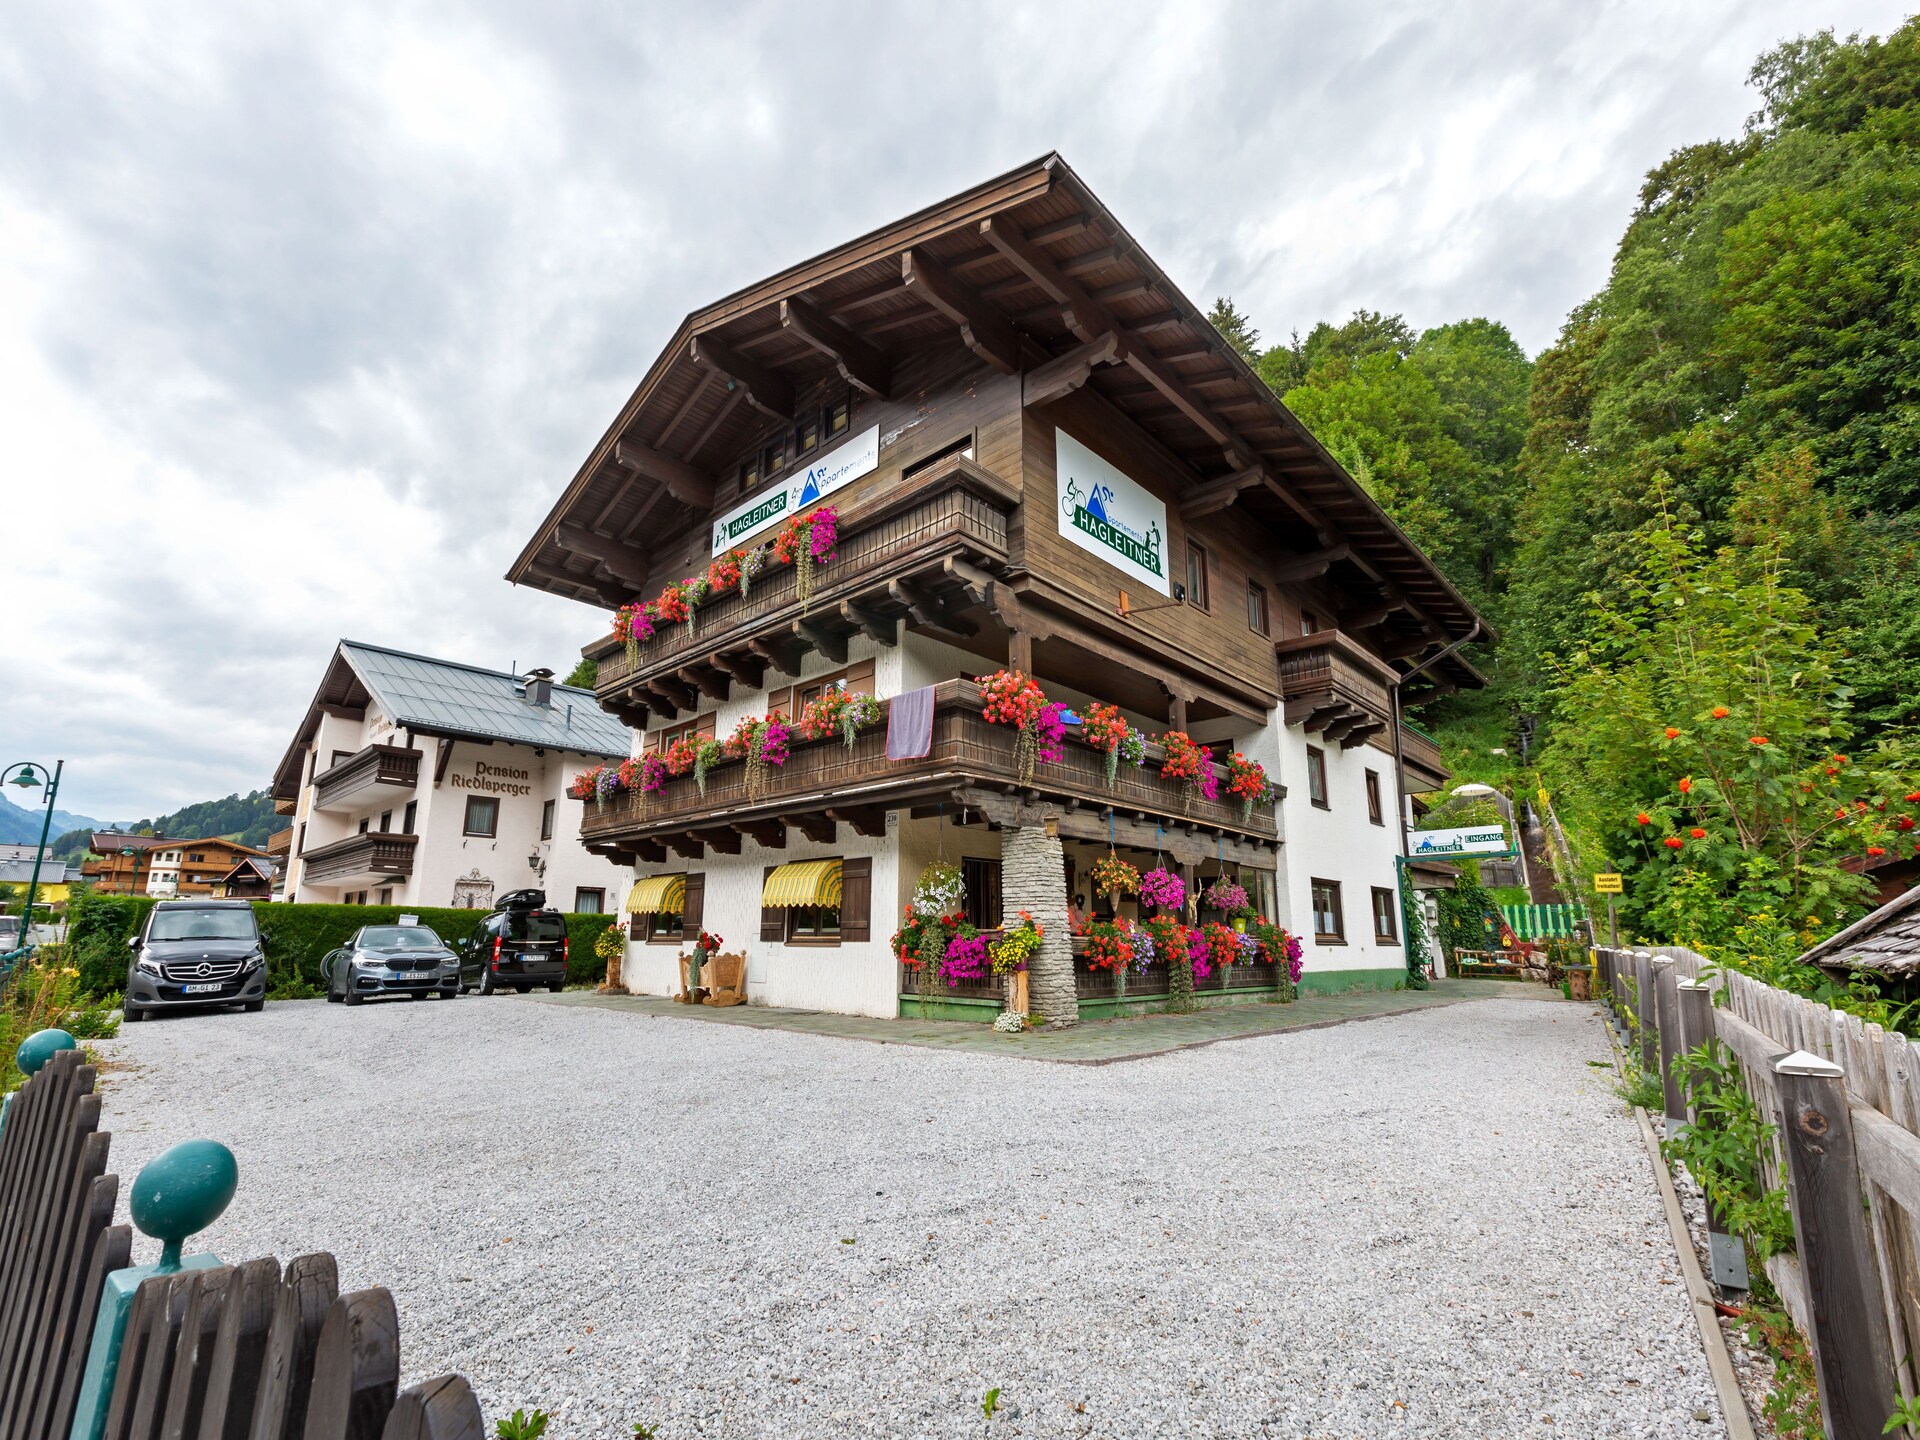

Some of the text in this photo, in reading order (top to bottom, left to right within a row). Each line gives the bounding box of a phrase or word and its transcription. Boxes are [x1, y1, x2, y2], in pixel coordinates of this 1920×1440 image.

[731, 495, 784, 536] HAGLEITNER
[1080, 510, 1157, 572] HAGLEITNER
[475, 761, 529, 780] Pension
[451, 773, 531, 797] Riedlsperger
[1465, 833, 1502, 843] EINGANG
[1418, 844, 1460, 854] HAGLEITNER
